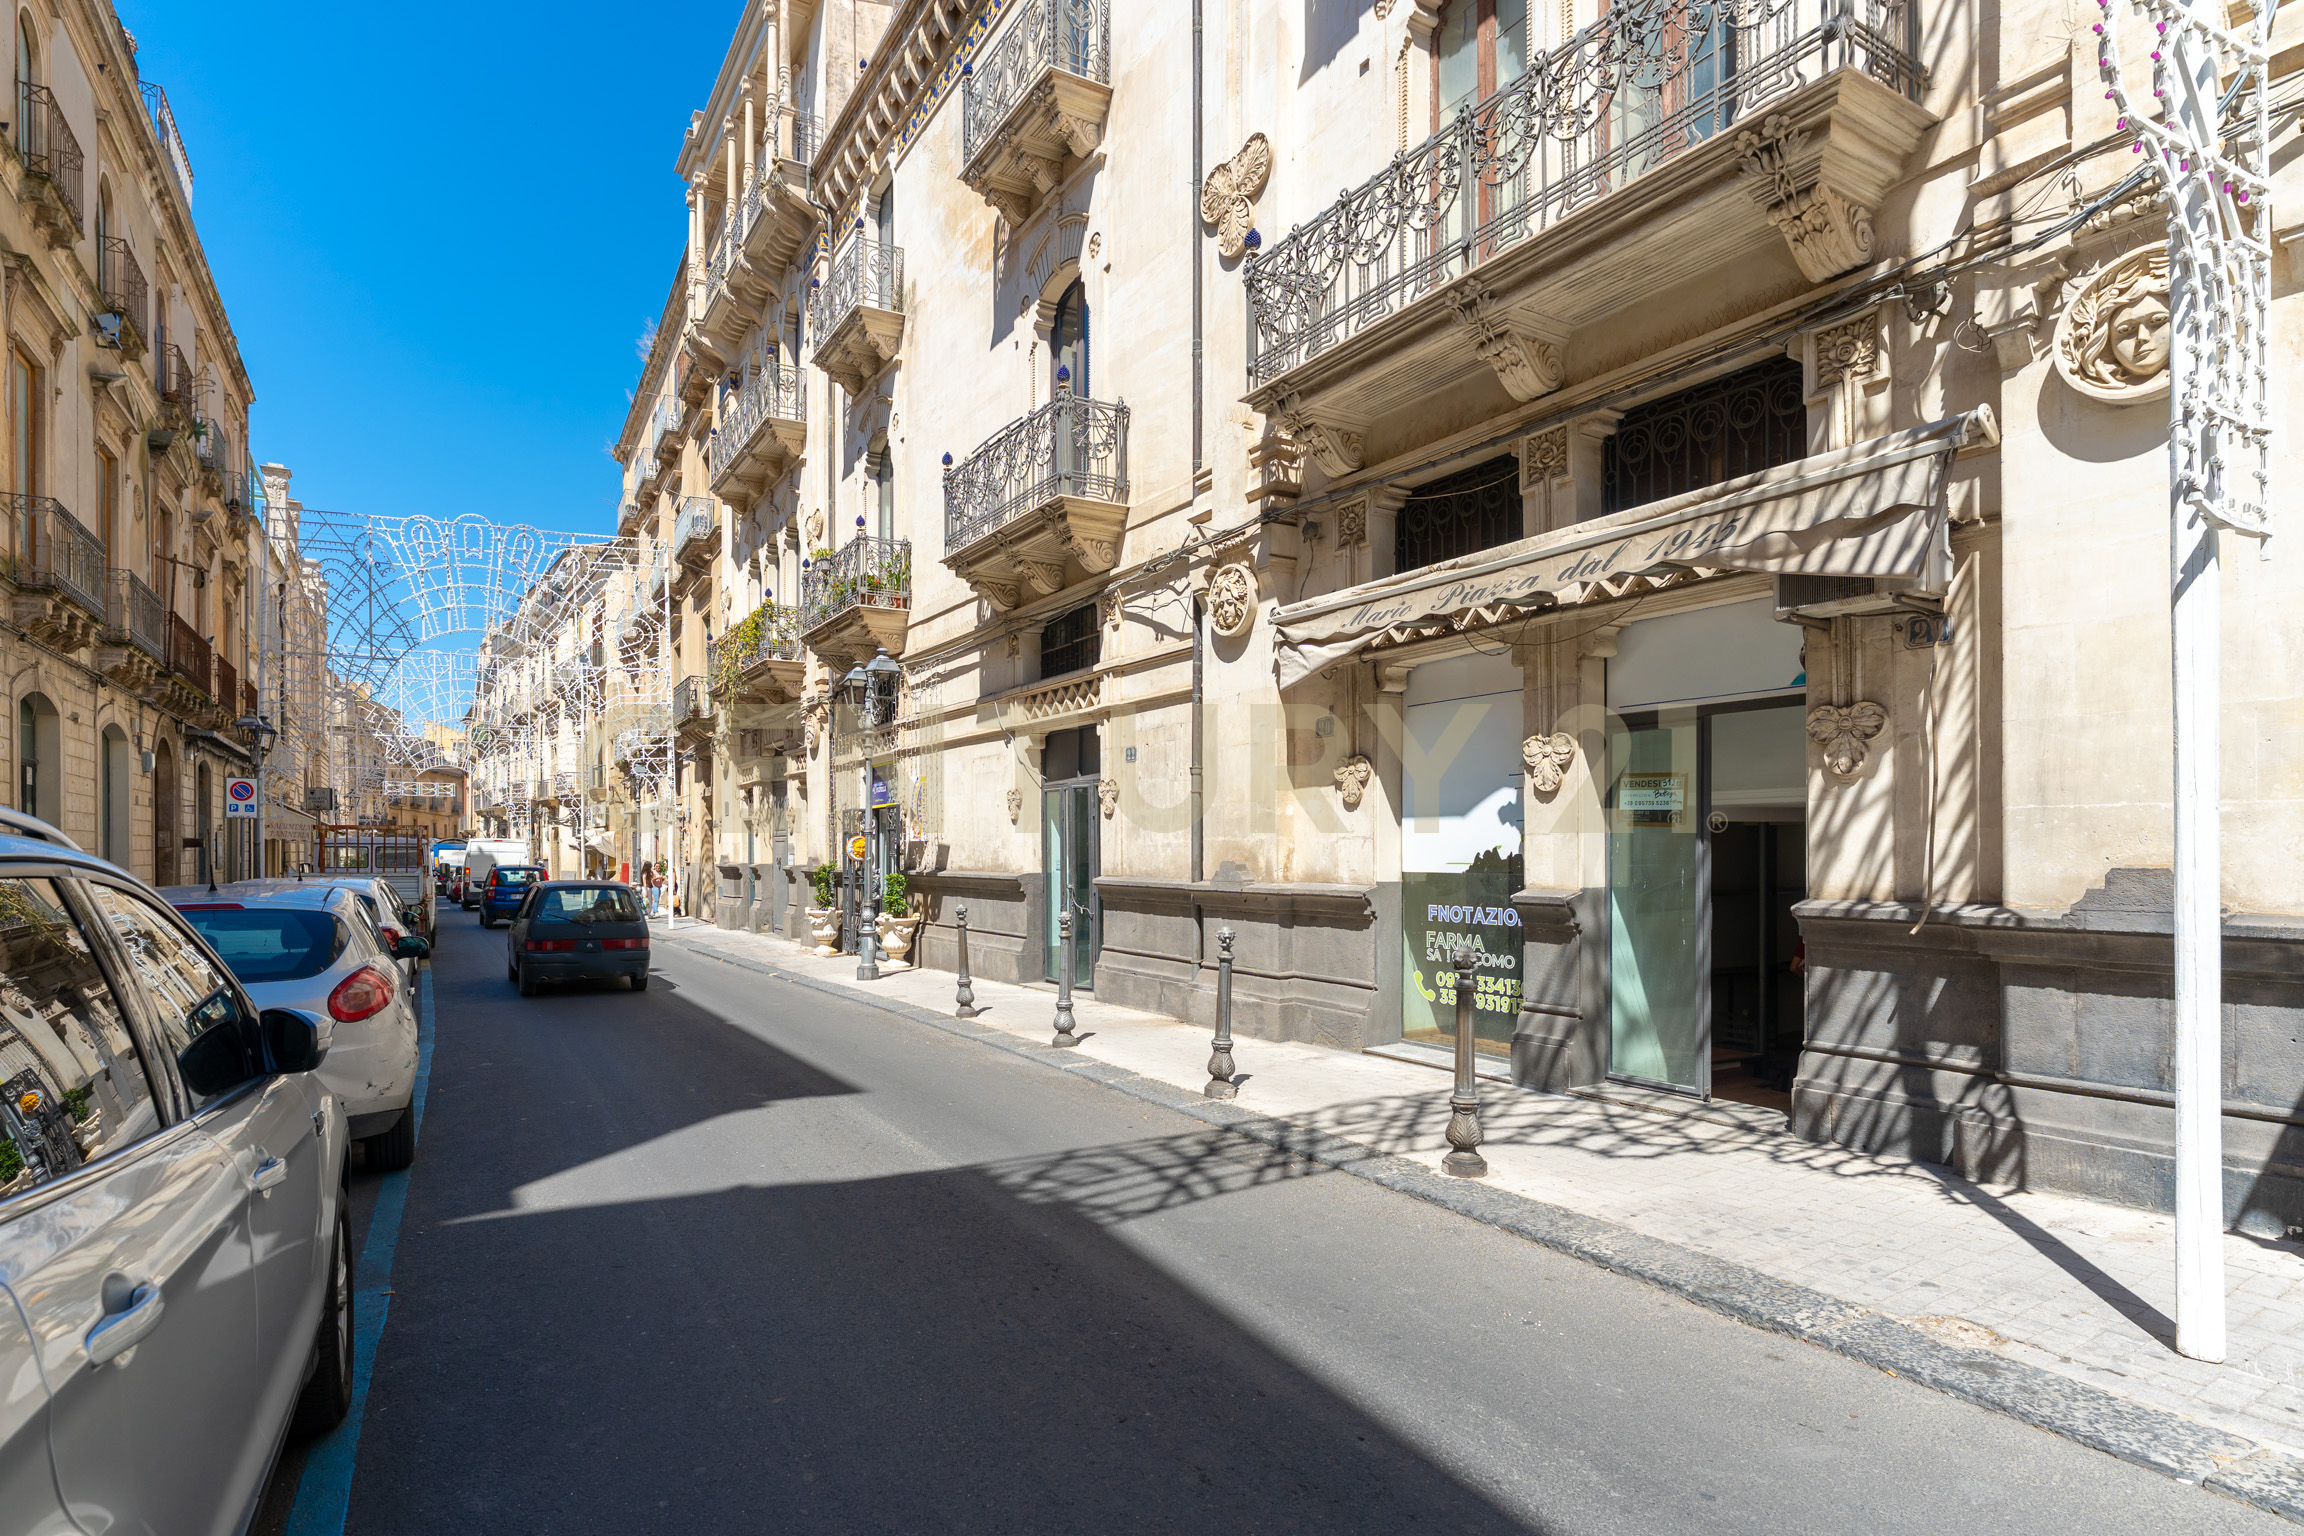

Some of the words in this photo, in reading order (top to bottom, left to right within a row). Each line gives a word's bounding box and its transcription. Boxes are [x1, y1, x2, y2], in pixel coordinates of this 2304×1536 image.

[1342, 601, 1413, 629] Mario
[1430, 575, 1541, 611] Piazza
[1558, 539, 1633, 582] dal
[1644, 516, 1744, 561] 1945
[1623, 780, 1660, 788] VENDESI
[270, 822, 310, 831] SALUMERIA
[1428, 904, 1523, 927] FNOTAZIO
